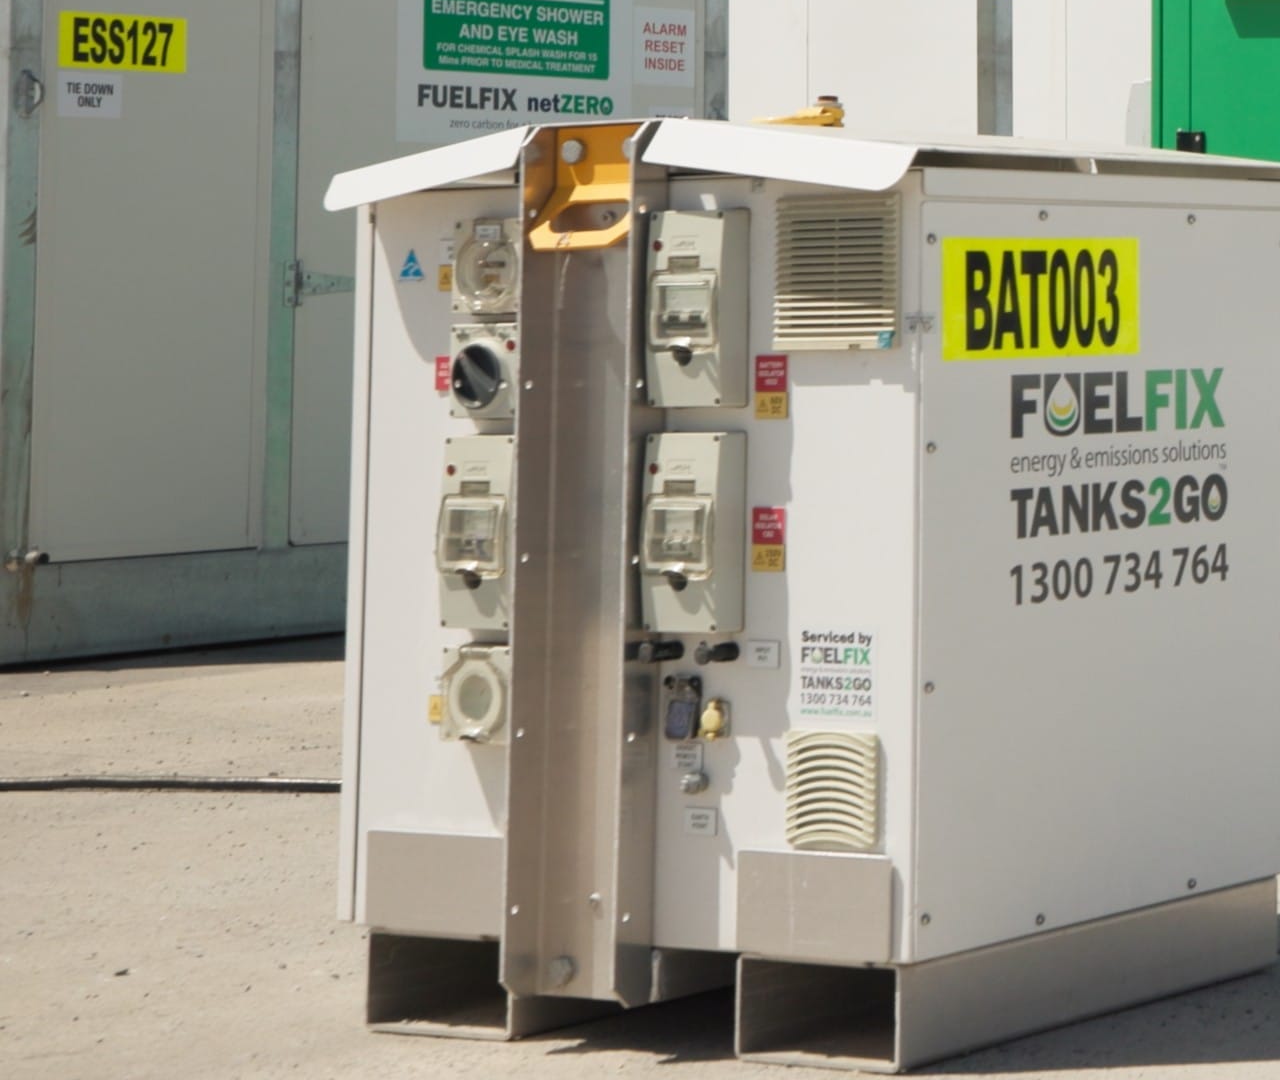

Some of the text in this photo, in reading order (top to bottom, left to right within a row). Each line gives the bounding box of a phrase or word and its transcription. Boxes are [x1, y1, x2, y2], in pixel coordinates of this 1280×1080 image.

[536, 5, 604, 26] SHOWER
[459, 24, 578, 46] AND EYE WASH
[643, 22, 687, 37] ALARM
[72, 16, 174, 67] ESS127
[644, 39, 685, 54] RESET
[436, 42, 598, 62] FOR CHEMICAL SPLASH WASH FOR 15
[461, 56, 488, 66] PRIOR
[491, 58, 503, 68] TO
[505, 59, 543, 70] MEDICAL
[545, 62, 595, 73] TREATMENT
[644, 56, 685, 71] INSIDE
[66, 81, 114, 95] TIE DOWN
[417, 83, 517, 111] FUELFIX
[77, 95, 102, 108] ONLY
[527, 93, 614, 116] netZERO
[472, 119, 505, 130] carbon
[965, 249, 1121, 351] BAT003
[1011, 367, 1226, 439] FUELFIX
[1011, 439, 1227, 477] energy & emissions solutions
[1011, 473, 1228, 540] TANKS2GO
[1010, 543, 1229, 606] 1300 734 764
[801, 630, 873, 647] Serviced by
[801, 647, 871, 665] FUELFIX
[800, 675, 872, 692] TANKS2GO
[800, 692, 872, 707] 1300 734 764
